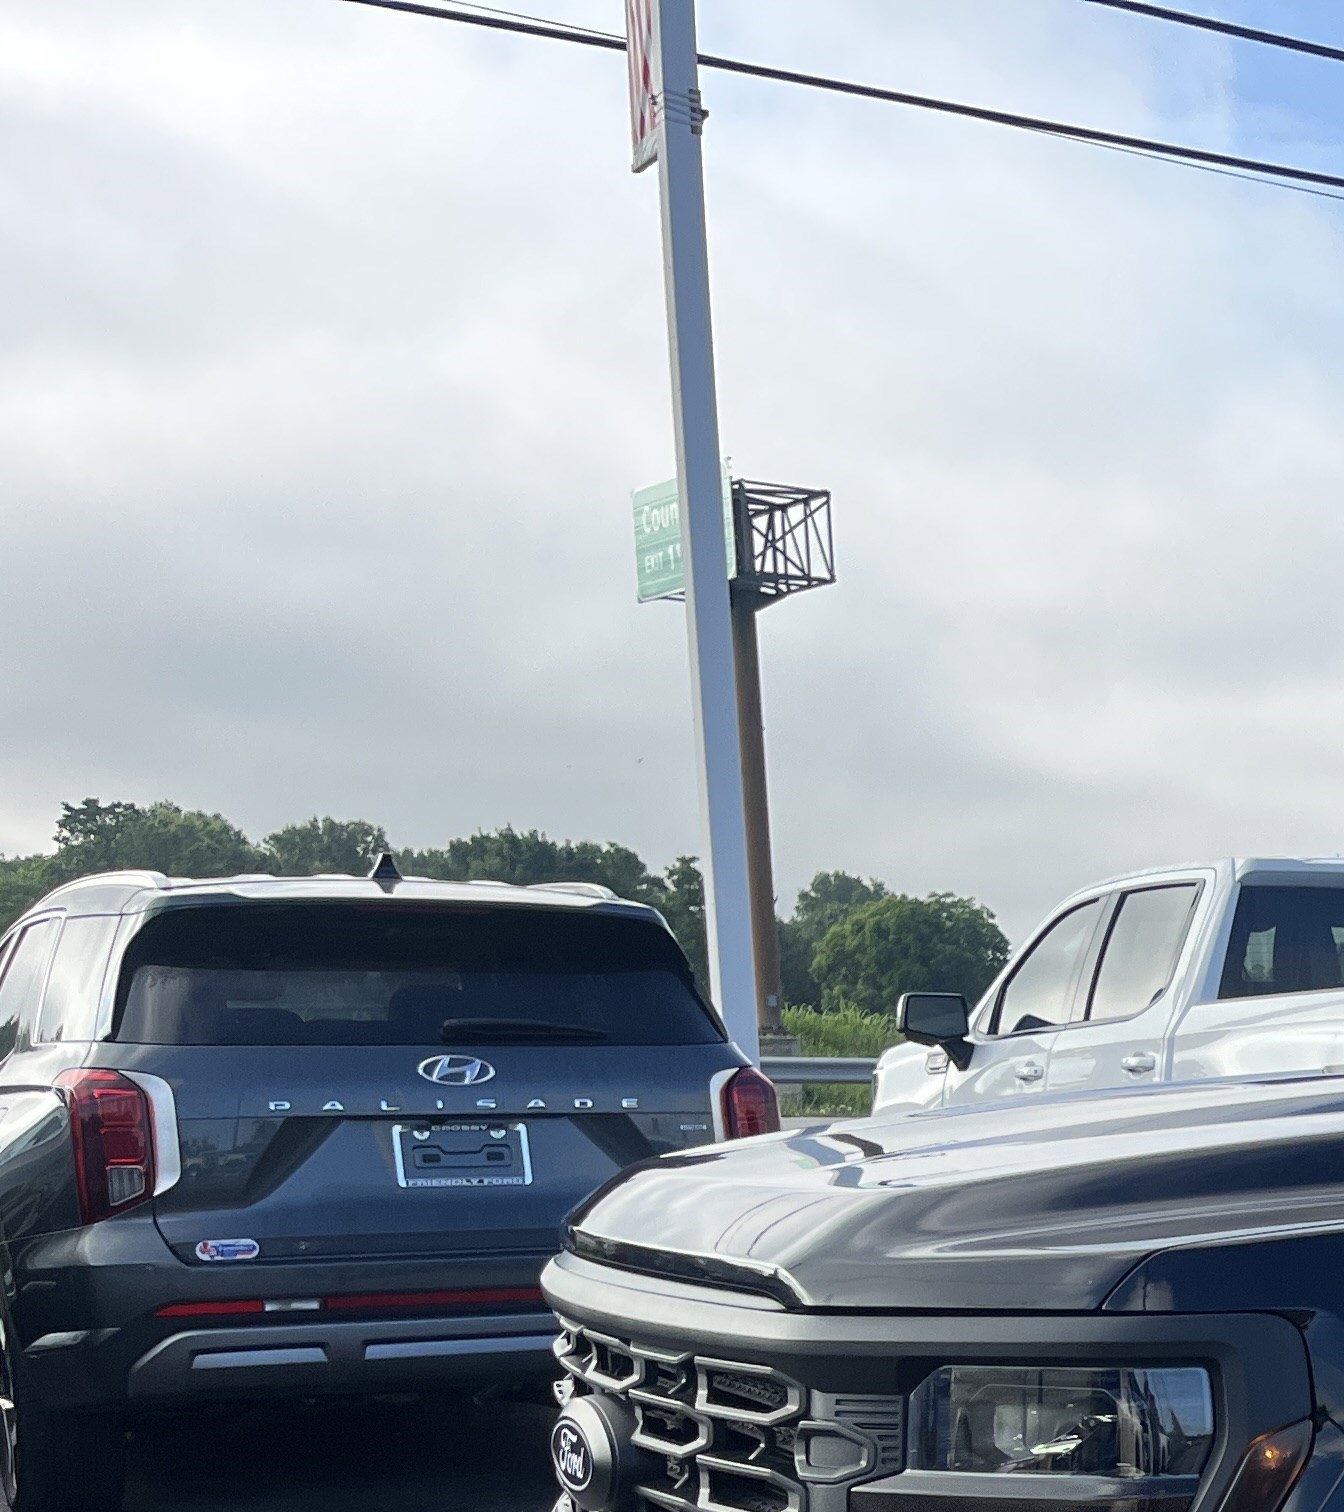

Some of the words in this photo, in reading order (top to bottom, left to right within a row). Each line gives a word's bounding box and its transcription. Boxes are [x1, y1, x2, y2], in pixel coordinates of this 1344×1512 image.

[268, 1097, 639, 1112] PALISADE
[408, 1177, 480, 1187] FRIENDLY
[484, 1177, 523, 1186] FORD
[560, 1427, 586, 1479] Ford
